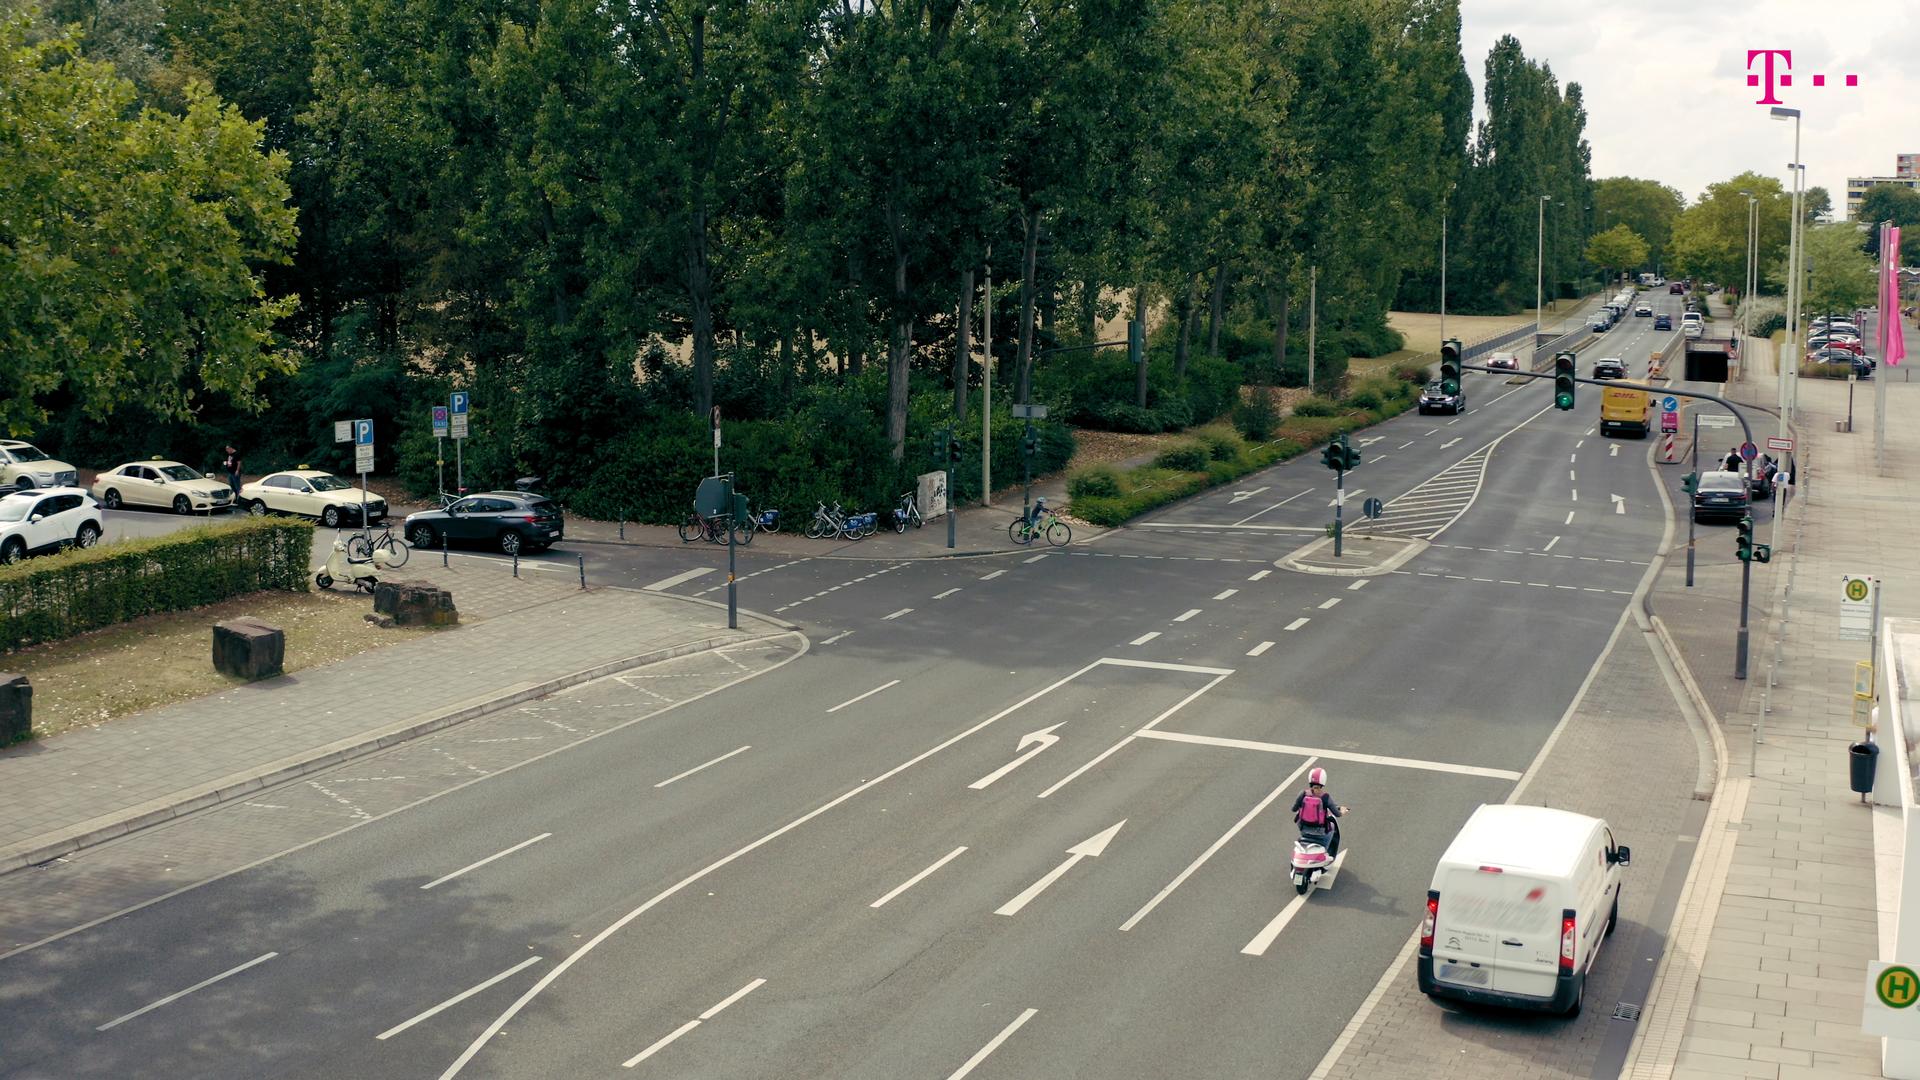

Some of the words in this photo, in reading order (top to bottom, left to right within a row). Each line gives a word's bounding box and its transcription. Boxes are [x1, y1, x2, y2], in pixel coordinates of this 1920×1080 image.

[454, 395, 464, 412] P
[360, 422, 369, 442] P
[1852, 584, 1862, 596] H
[1888, 975, 1910, 1000] H
